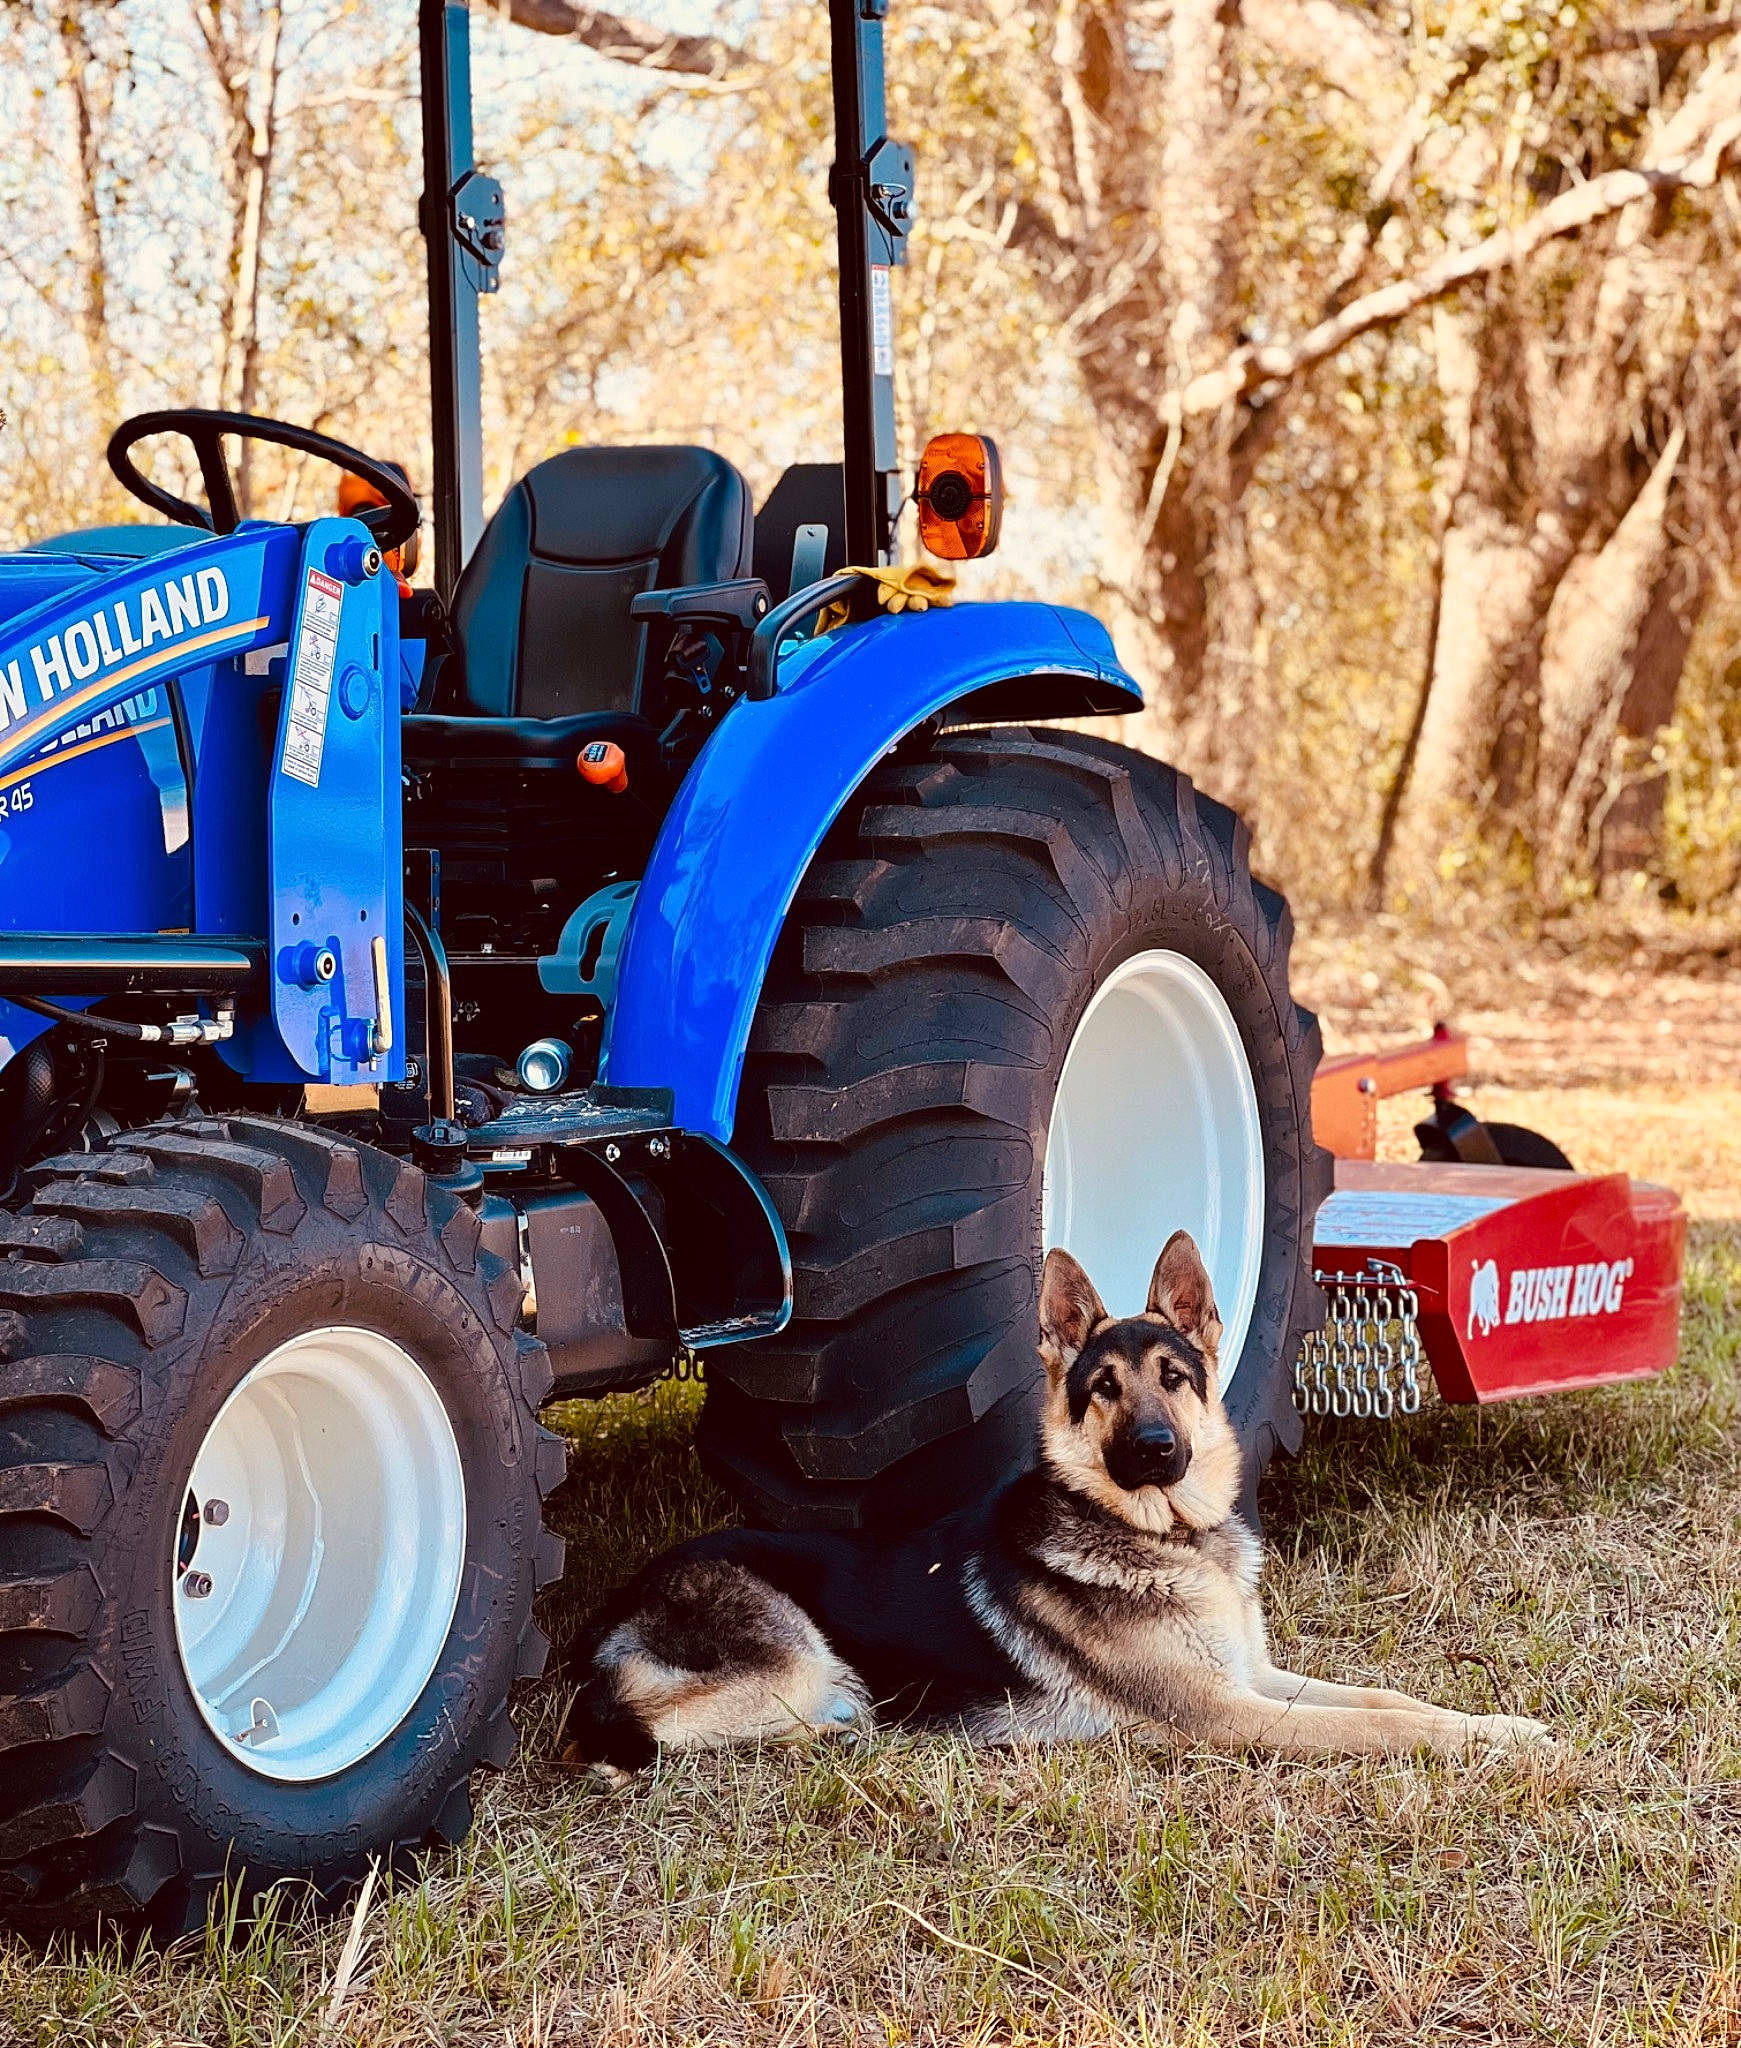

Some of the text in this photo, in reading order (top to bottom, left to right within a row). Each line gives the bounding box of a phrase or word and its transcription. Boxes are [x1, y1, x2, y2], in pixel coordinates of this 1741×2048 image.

[29, 566, 230, 703] HOLLAND
[11, 781, 34, 812] 45
[1505, 1265, 1574, 1325] BUSH
[120, 1609, 167, 1725] FWD
